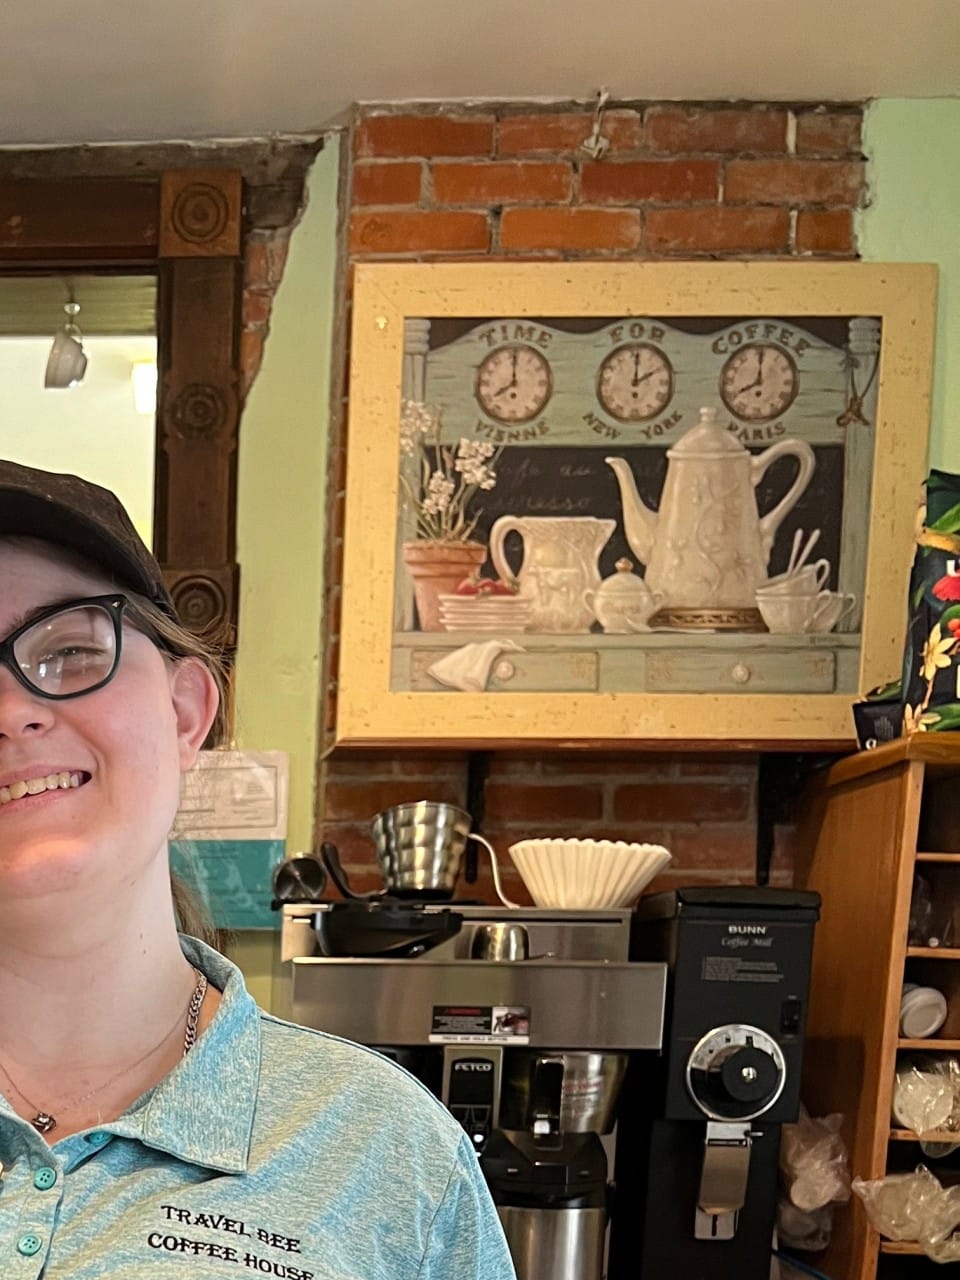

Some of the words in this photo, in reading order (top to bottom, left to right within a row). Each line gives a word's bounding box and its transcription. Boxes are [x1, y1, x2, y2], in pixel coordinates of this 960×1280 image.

[478, 323, 553, 349] TIME
[609, 322, 667, 345] FOR
[711, 323, 812, 358] COFFEE
[475, 420, 551, 442] VIENNE
[582, 412, 621, 440] NEW
[640, 410, 684, 440] YORK
[728, 925, 766, 935] BUNN
[160, 1205, 252, 1238] TRAVEL
[256, 1228, 302, 1254] BEE
[147, 1232, 239, 1263] COFFEE
